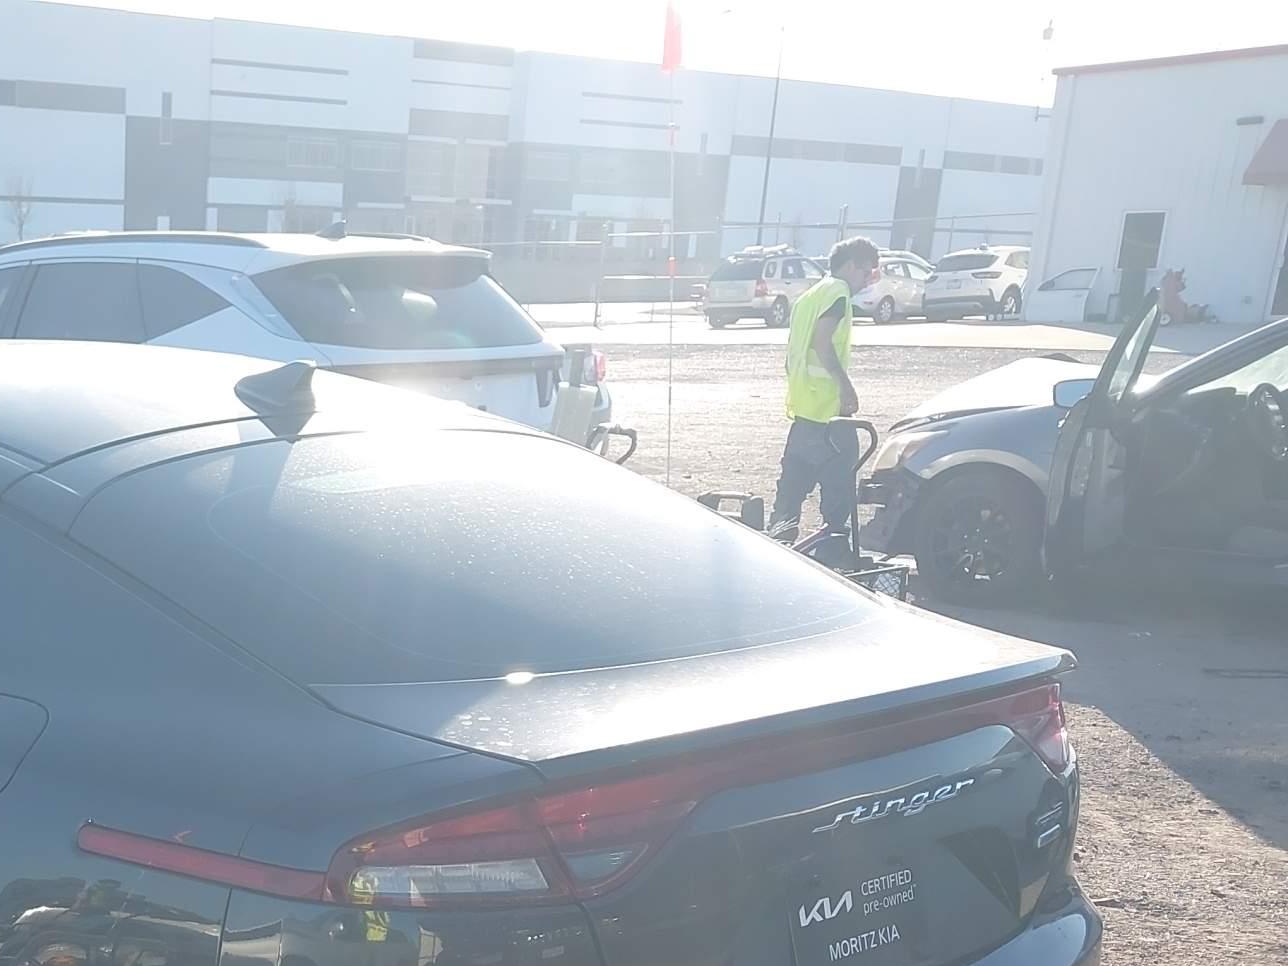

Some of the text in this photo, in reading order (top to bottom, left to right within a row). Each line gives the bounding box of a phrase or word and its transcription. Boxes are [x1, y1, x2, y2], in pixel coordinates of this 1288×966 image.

[812, 778, 976, 833] stinger
[861, 869, 912, 896] CERTIFIED
[863, 885, 914, 916] pre-owned
[829, 924, 901, 961] MORITZ KIA
